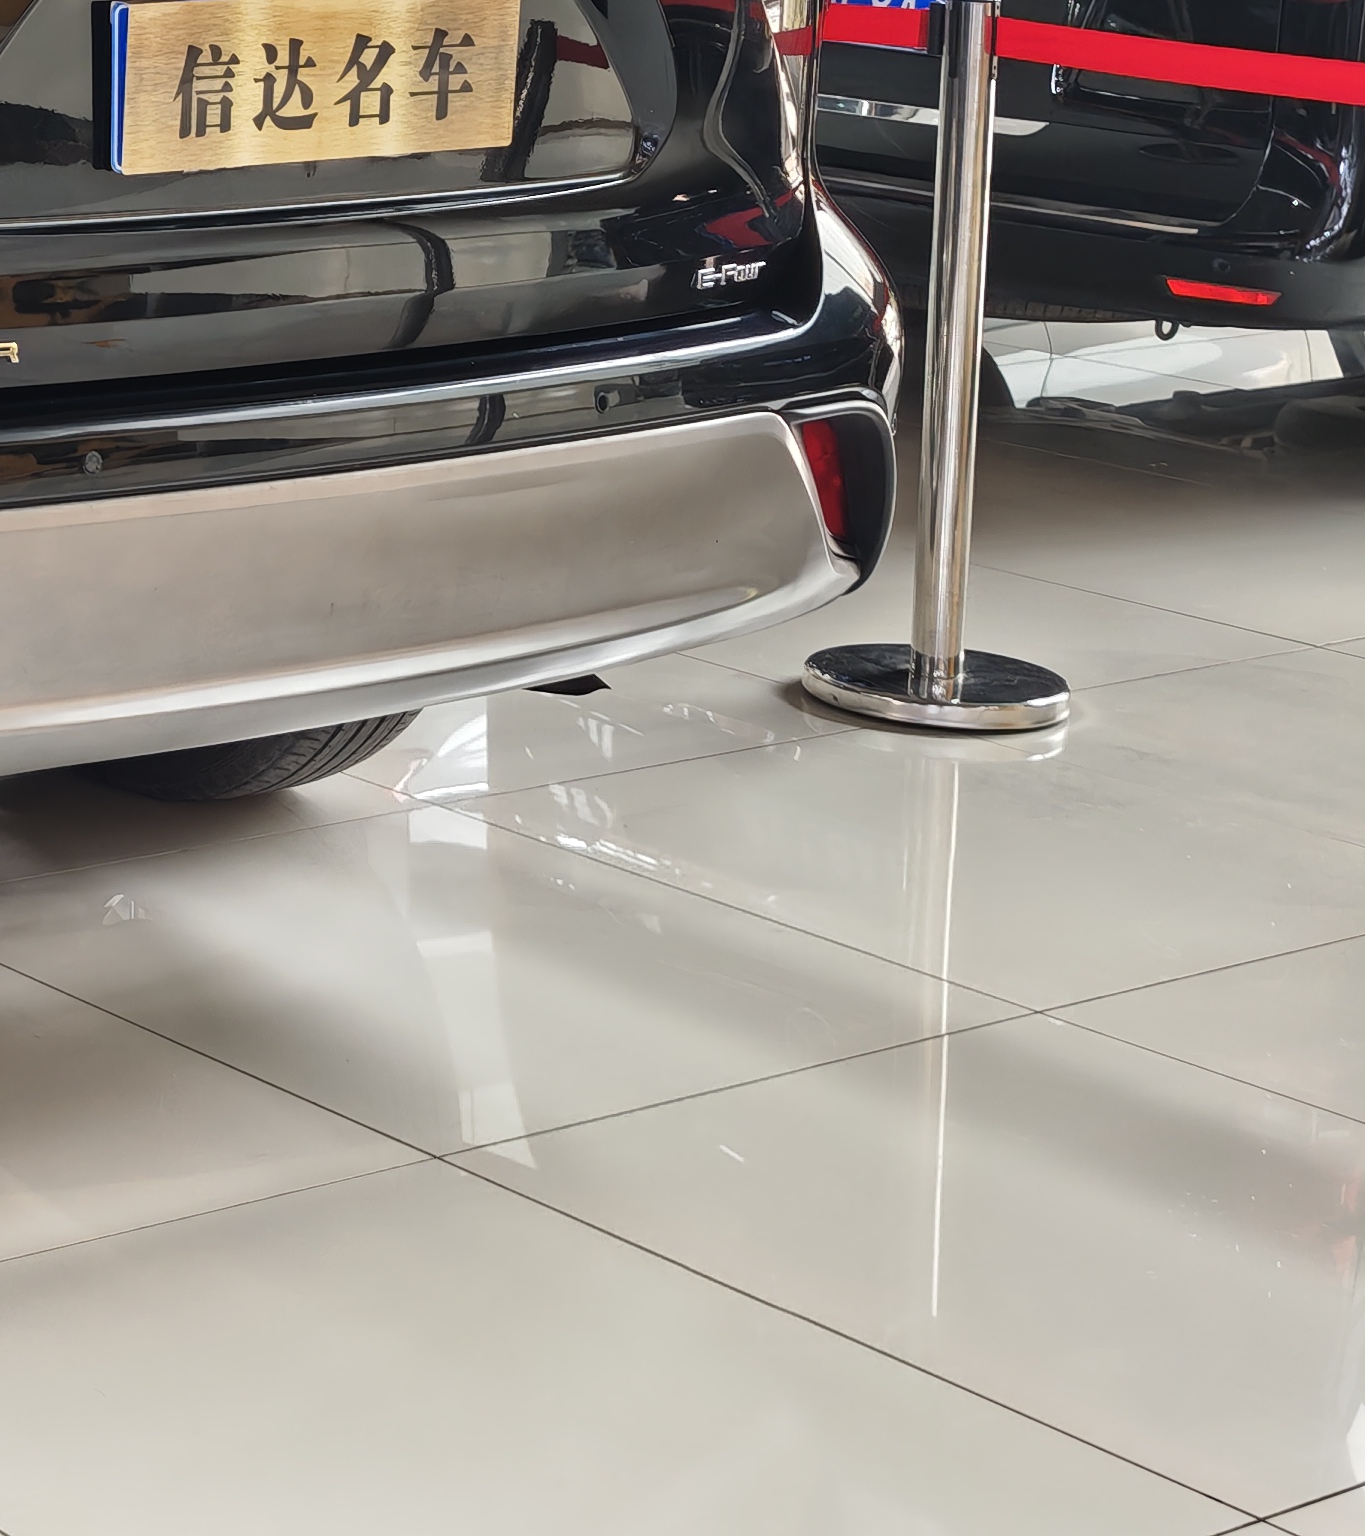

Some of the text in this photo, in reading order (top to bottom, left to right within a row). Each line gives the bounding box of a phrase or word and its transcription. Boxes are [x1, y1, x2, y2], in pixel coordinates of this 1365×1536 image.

[173, 28, 477, 140] 信达名车
[694, 259, 767, 291] E-Four
